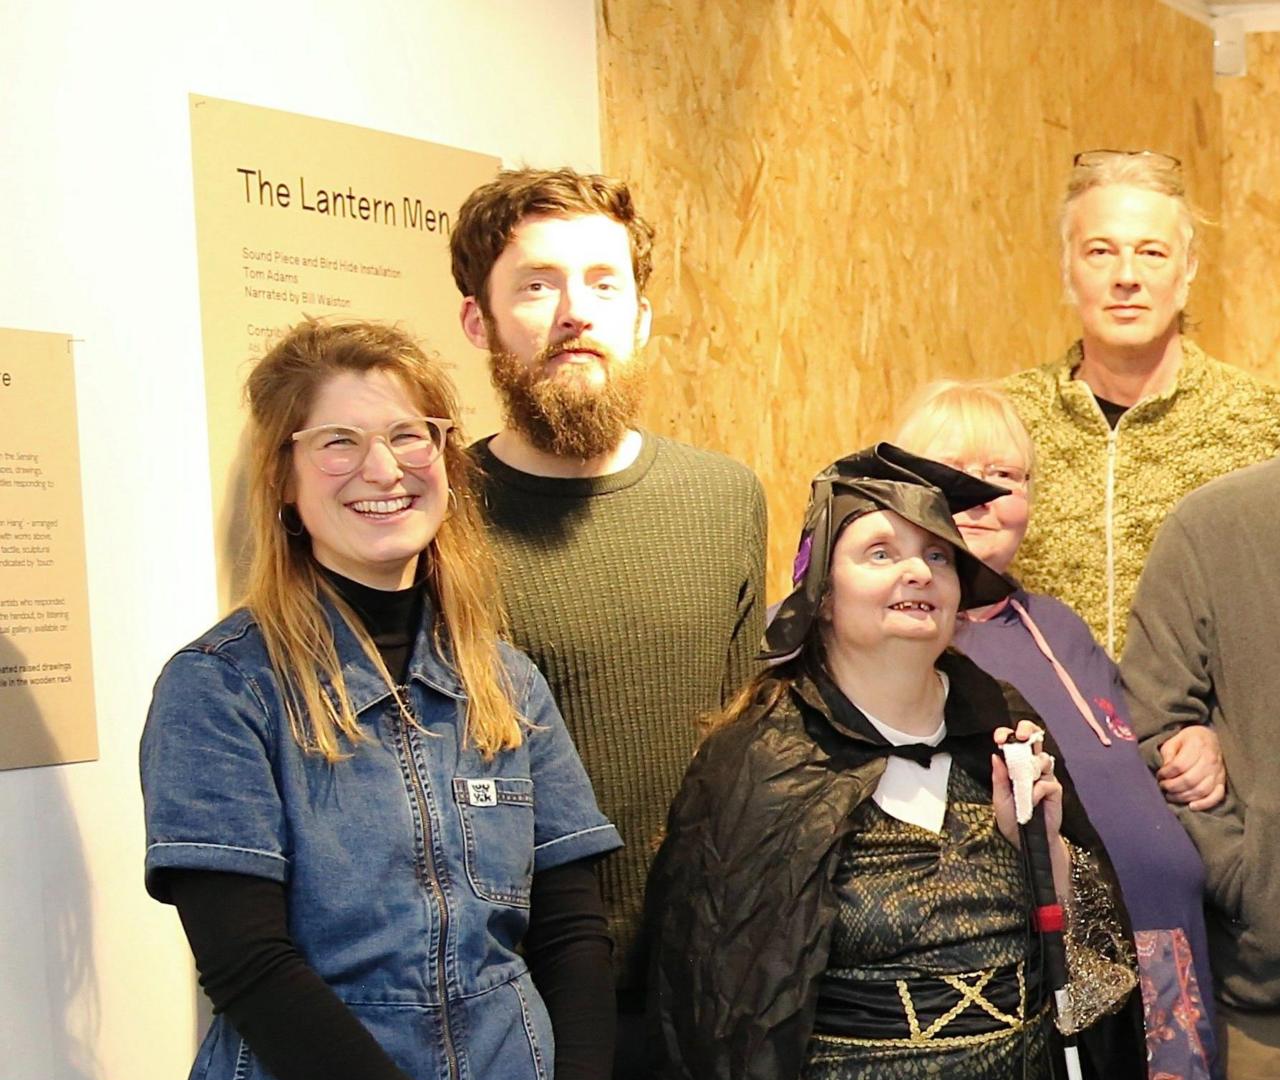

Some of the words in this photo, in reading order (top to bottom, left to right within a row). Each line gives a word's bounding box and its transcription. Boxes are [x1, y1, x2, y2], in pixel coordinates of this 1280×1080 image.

[237, 168, 290, 208] The
[300, 177, 397, 226] Lantern
[403, 197, 451, 235] Men
[242, 247, 272, 262] Sound
[274, 251, 301, 266] Piece
[302, 256, 318, 268] and
[320, 257, 338, 271] Bird
[340, 260, 358, 273] Hide
[360, 263, 402, 279] Installation
[242, 266, 265, 280] Tom
[267, 269, 299, 284] Adams
[245, 286, 287, 302] Narrated
[289, 291, 299, 305] by
[302, 292, 316, 305] Bill
